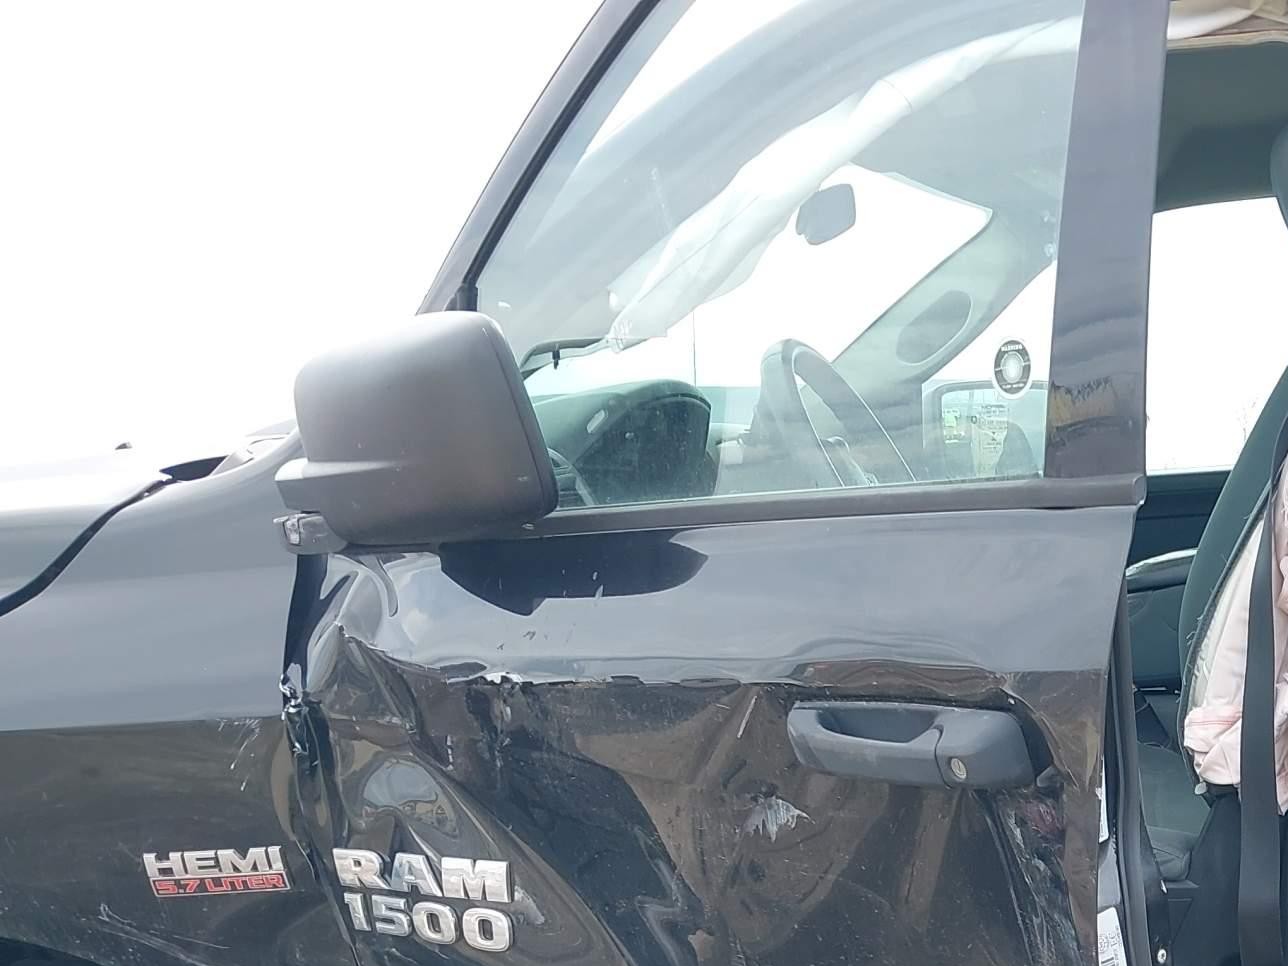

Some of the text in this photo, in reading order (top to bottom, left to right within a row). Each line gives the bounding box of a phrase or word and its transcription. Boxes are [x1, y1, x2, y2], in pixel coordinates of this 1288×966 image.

[143, 846, 285, 877] HEMI
[332, 848, 513, 903] RAM
[155, 874, 285, 894] 5.7 LITER
[343, 892, 514, 953] 1500
